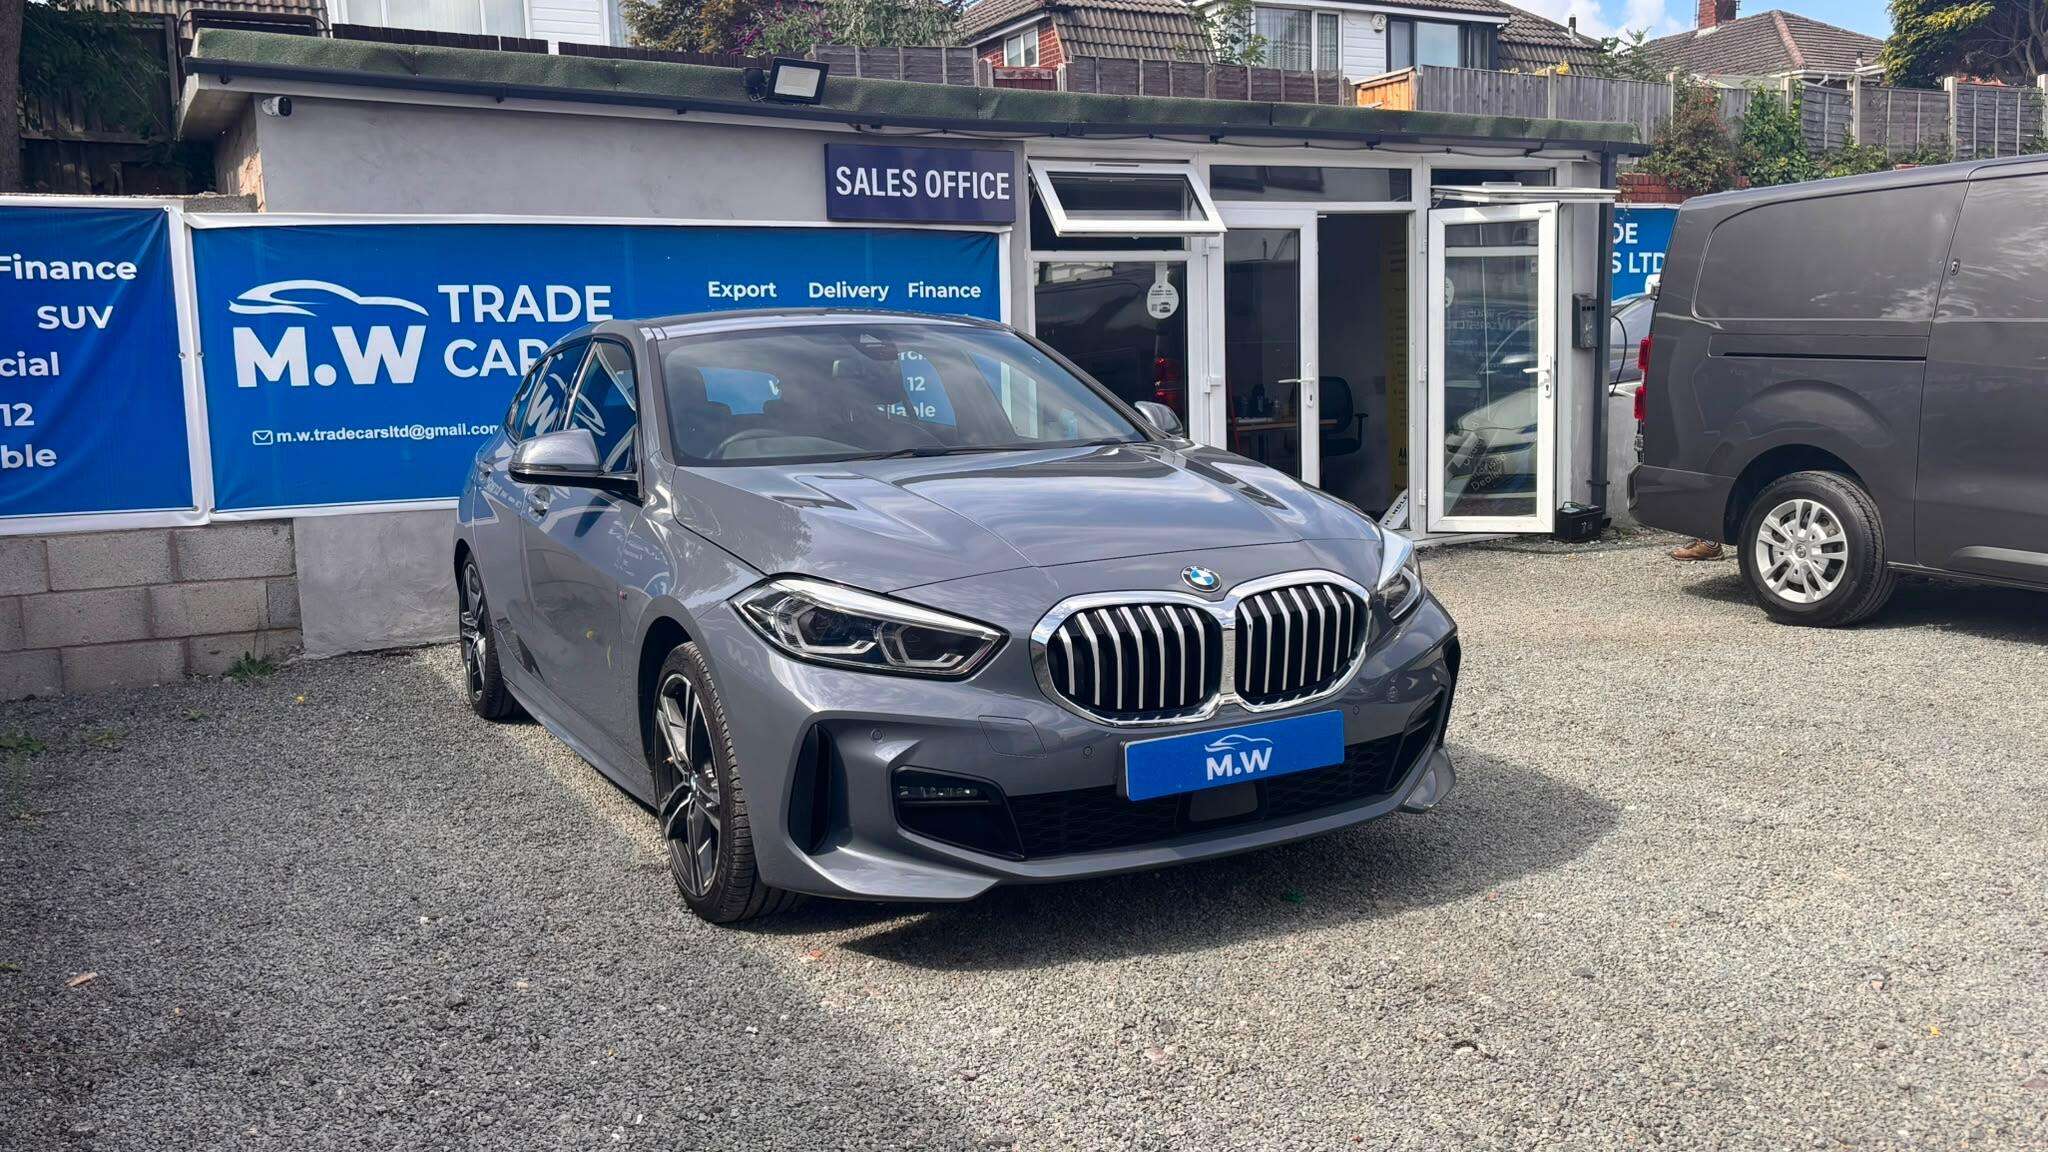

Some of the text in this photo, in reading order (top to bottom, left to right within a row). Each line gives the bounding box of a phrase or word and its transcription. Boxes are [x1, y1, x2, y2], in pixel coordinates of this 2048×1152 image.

[836, 166, 1010, 200] SALES OFFICE
[1628, 251, 1665, 273] LTD
[438, 284, 614, 323] TRADE
[708, 280, 982, 302] Export Delivery Finance
[37, 305, 114, 330] SUV
[232, 325, 427, 388] M.W
[444, 339, 550, 378] CAR
[906, 375, 926, 392] 12
[1206, 747, 1273, 781] M.W
